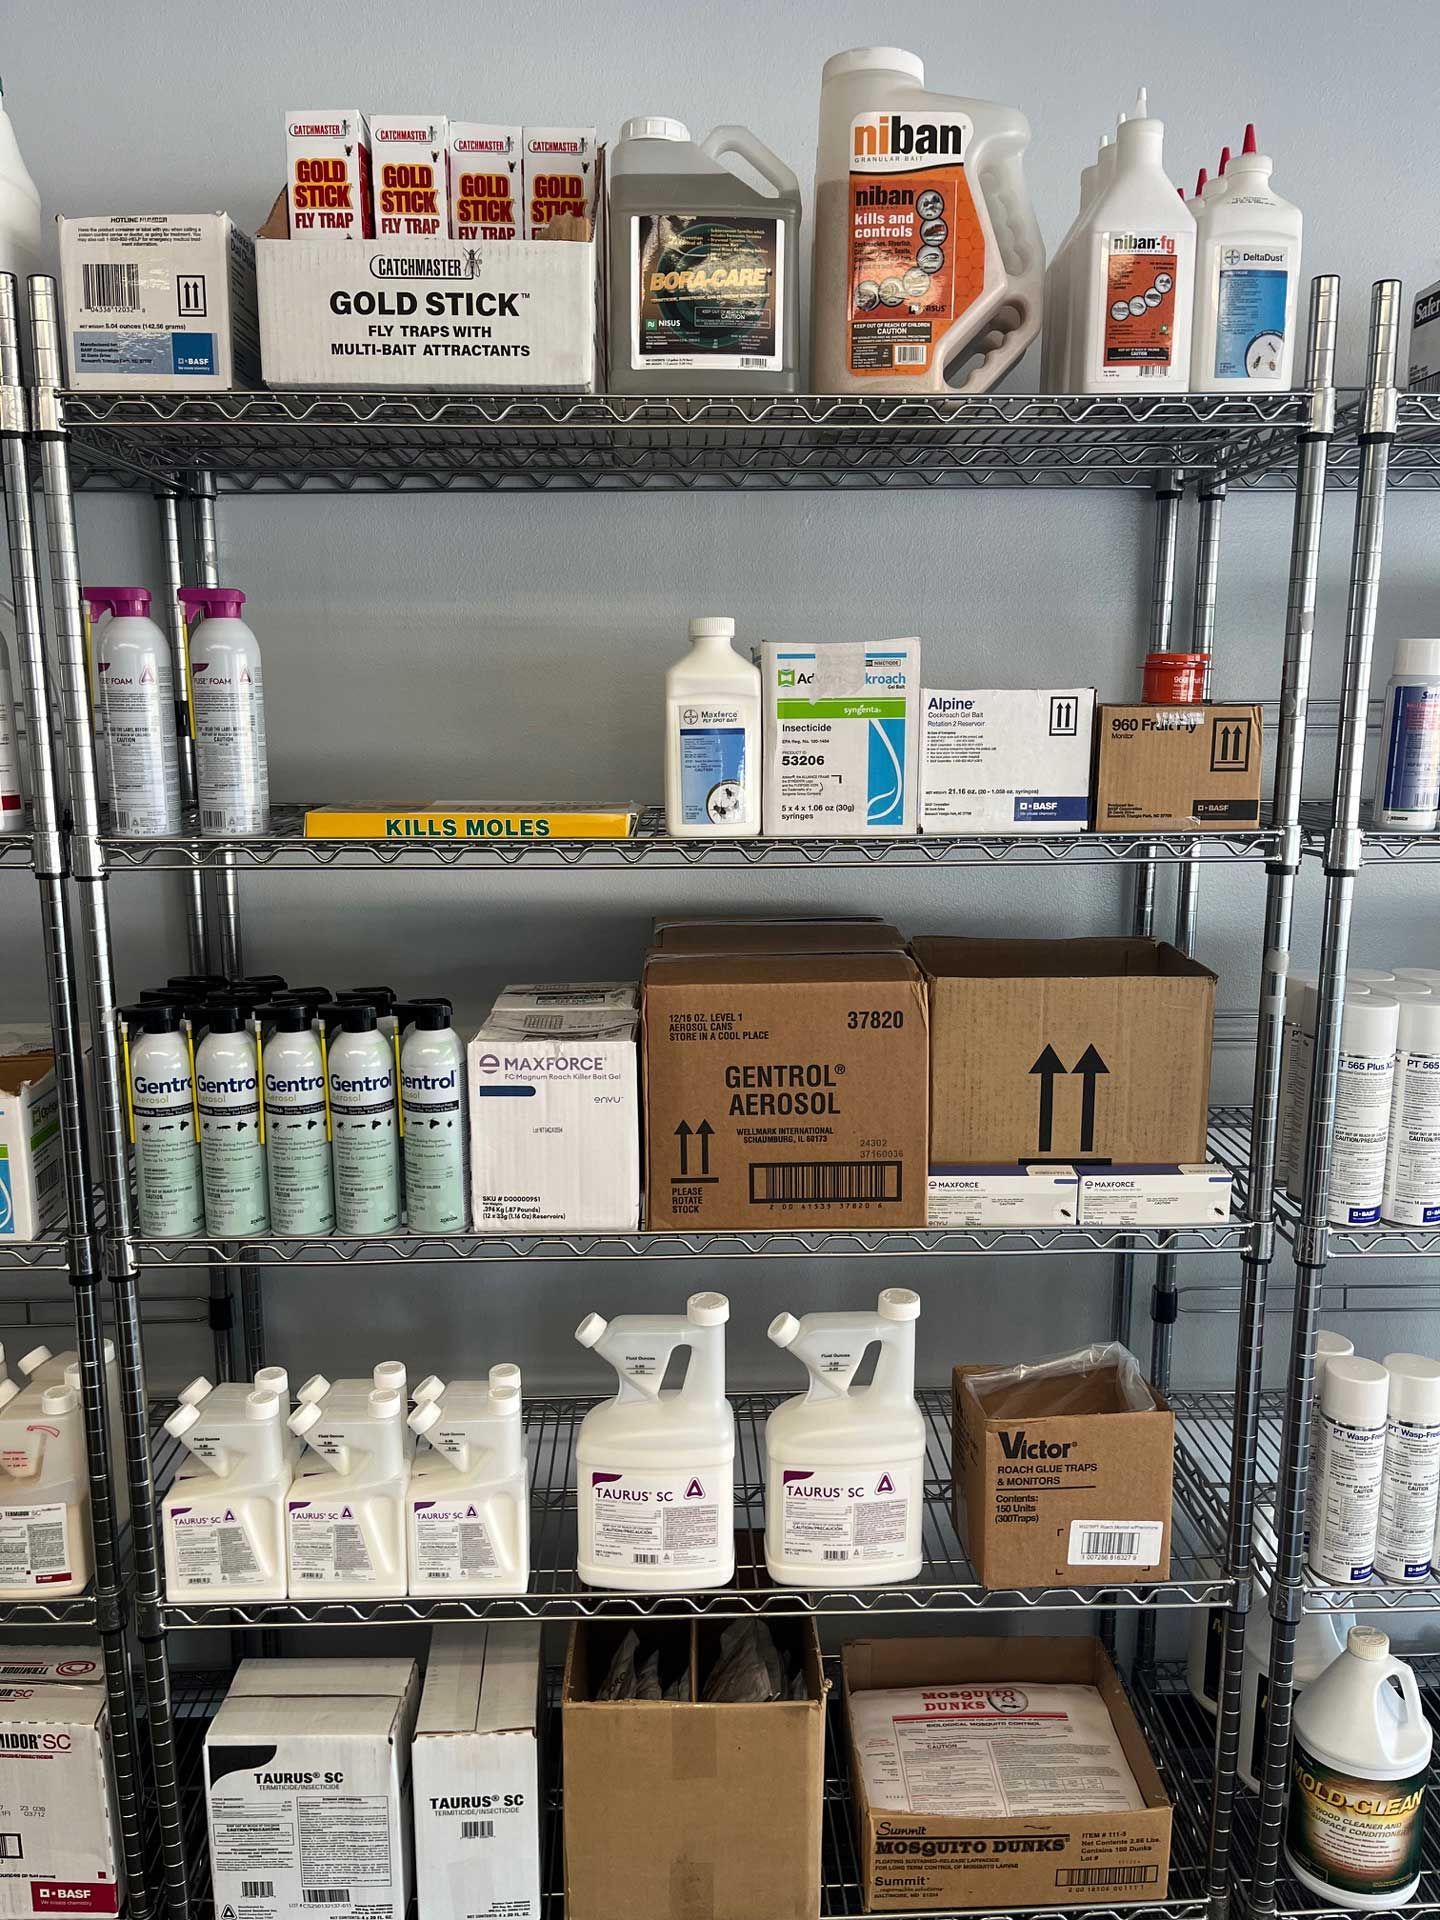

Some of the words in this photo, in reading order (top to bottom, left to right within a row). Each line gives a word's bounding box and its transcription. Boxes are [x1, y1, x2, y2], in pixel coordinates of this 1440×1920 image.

[293, 125, 340, 136] CATCHMASTER
[380, 130, 427, 141] CATCHMASTER
[854, 115, 962, 155] niban
[458, 140, 504, 151] CATCHMASTER
[532, 141, 578, 152] CATCHMASTER
[297, 160, 346, 183] GOLD
[383, 165, 431, 188] GOLD
[461, 175, 508, 198] GOLD
[535, 175, 582, 198] GOLD
[295, 184, 350, 208] STICK
[381, 190, 437, 214] STICK
[855, 186, 914, 206] niban
[459, 199, 513, 223] STICK
[295, 213, 317, 229] FLY
[318, 212, 354, 228] TRAP
[855, 213, 885, 225] kills
[888, 213, 914, 225] and
[381, 218, 403, 234] FLY
[404, 217, 440, 234] TRAP
[855, 226, 913, 239] controls
[1243, 252, 1284, 263] DeltaDust
[378, 255, 461, 277] CATCHMASTER
[650, 268, 767, 292] BORA-CARE
[329, 291, 418, 316] GOLD
[658, 319, 681, 327] NISUS
[368, 325, 394, 338] FLY
[400, 325, 450, 338] TRAPS
[453, 325, 492, 338] WITH
[331, 343, 416, 356] MULTI-BAIT
[423, 344, 531, 357] ATTRACTANTS
[844, 705, 880, 715] syngenta
[928, 698, 972, 713] Alpine
[782, 724, 832, 732] Insecticide
[1112, 719, 1138, 731] 960
[782, 755, 825, 766] 53206
[836, 805, 855, 813] (30g)
[1033, 802, 1057, 810] BASF
[781, 813, 815, 821] syringes
[386, 819, 457, 836] KILLS
[466, 819, 550, 836] MOLES
[669, 1014, 692, 1022] 12/16
[693, 1014, 708, 1022] OZ.
[711, 1014, 736, 1022] LEVEL
[847, 1011, 904, 1029] 37820
[669, 1023, 709, 1032] AEROSOL
[711, 1022, 733, 1031] CANS
[669, 1032, 697, 1041] STORE
[699, 1032, 708, 1040] IN
[710, 1032, 717, 1040] A
[718, 1032, 741, 1040] COOL
[743, 1031, 769, 1040] PLACE
[505, 1057, 604, 1071] MAXFORCE
[1347, 1062, 1365, 1070] 565
[1407, 1060, 1419, 1068] PT
[134, 1077, 193, 1095] Gentro
[265, 1074, 324, 1093] Gentro
[729, 1092, 841, 1116] AEROSOL
[736, 1128, 777, 1136] WELLMARK
[778, 1127, 834, 1135] INTERNATIONAL
[744, 1136, 796, 1144] SCHAUMBURG,
[860, 1139, 888, 1147] 24302
[672, 1187, 703, 1196] PLEASE
[672, 1196, 703, 1205] ROTATE
[672, 1205, 700, 1214] STOCK
[1333, 1428, 1344, 1437] PT
[1388, 1425, 1399, 1433] PT
[998, 1432, 1070, 1459] Victor
[997, 1466, 1034, 1474] ROACH
[1036, 1465, 1062, 1473] GLUE
[1065, 1463, 1098, 1472] TRAPS
[997, 1478, 1004, 1486] &
[1006, 1477, 1060, 1485] MONITORS
[595, 1488, 649, 1501] TAURUS
[657, 1491, 673, 1502] SC
[786, 1486, 840, 1498] TAURUS
[848, 1487, 865, 1497] SC
[996, 1495, 1039, 1503] Contents:
[1013, 1504, 1036, 1512] Units
[922, 1690, 1014, 1700] MOSQUITO
[925, 1701, 986, 1711] DUNKS
[43, 1734, 71, 1749] SC
[324, 1772, 344, 1784] SC
[504, 1794, 524, 1806] SC
[435, 1807, 520, 1816] TERMITICIDE/INSECTICIDE
[1312, 1813, 1346, 1832] SURFACE
[1316, 1806, 1340, 1822] WOOD
[1343, 1818, 1382, 1830] CLEANER
[1384, 1822, 1402, 1830] AND
[875, 1841, 986, 1856] MOSQUITO
[992, 1839, 1065, 1854] DUNKS
[875, 1876, 925, 1886] Summit
[58, 1889, 91, 1899] BASF
